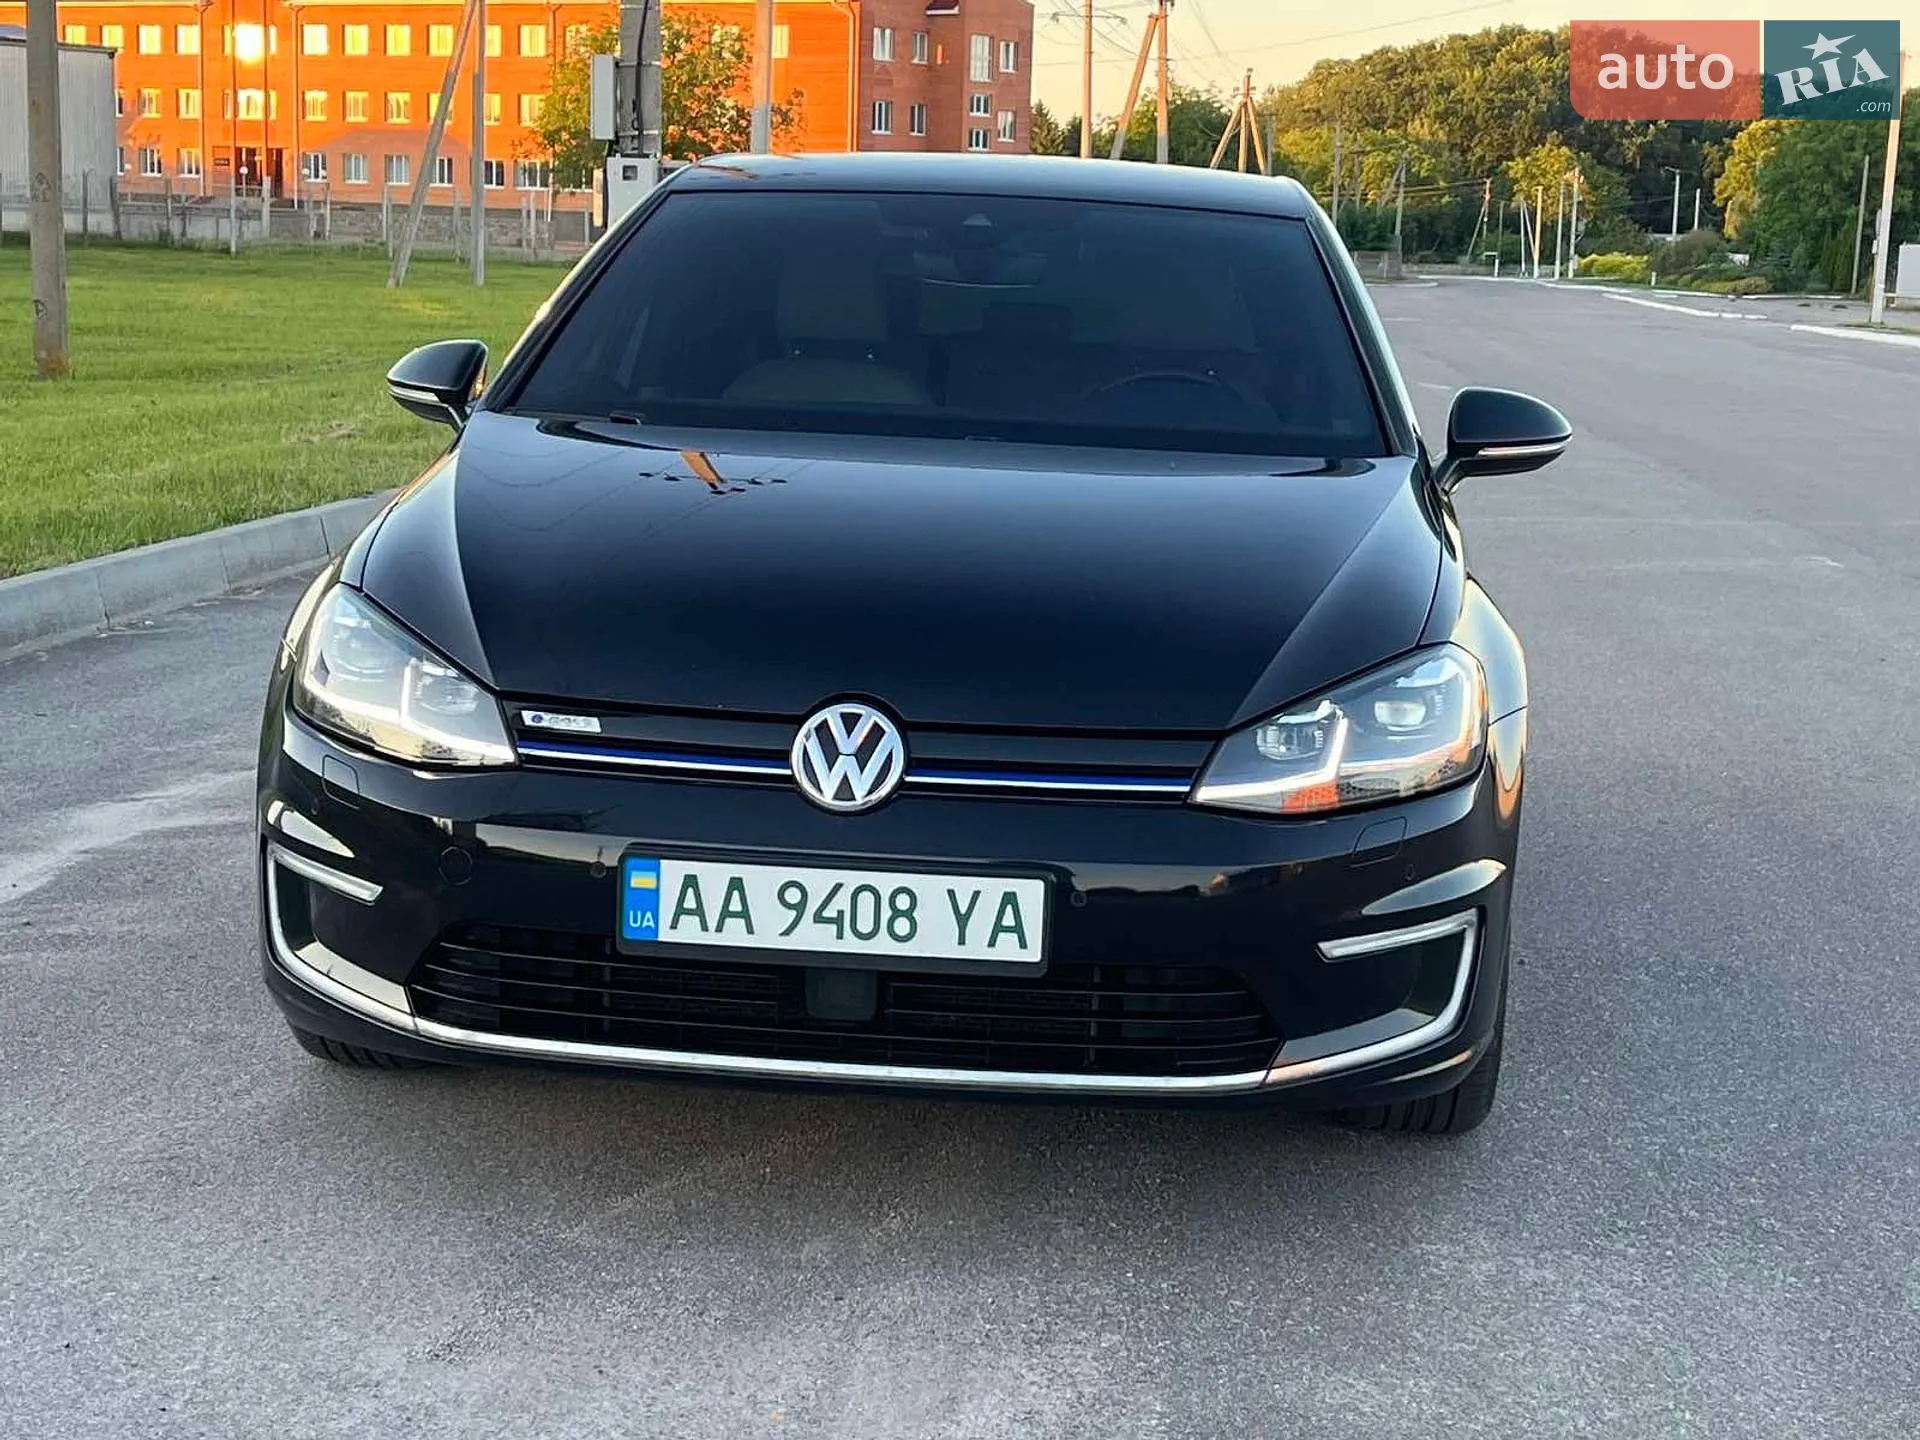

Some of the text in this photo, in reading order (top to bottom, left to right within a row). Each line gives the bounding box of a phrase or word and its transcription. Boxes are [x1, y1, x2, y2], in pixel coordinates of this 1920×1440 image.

[628, 910, 655, 929] UA
[669, 874, 1028, 949] AA 9408 YA
